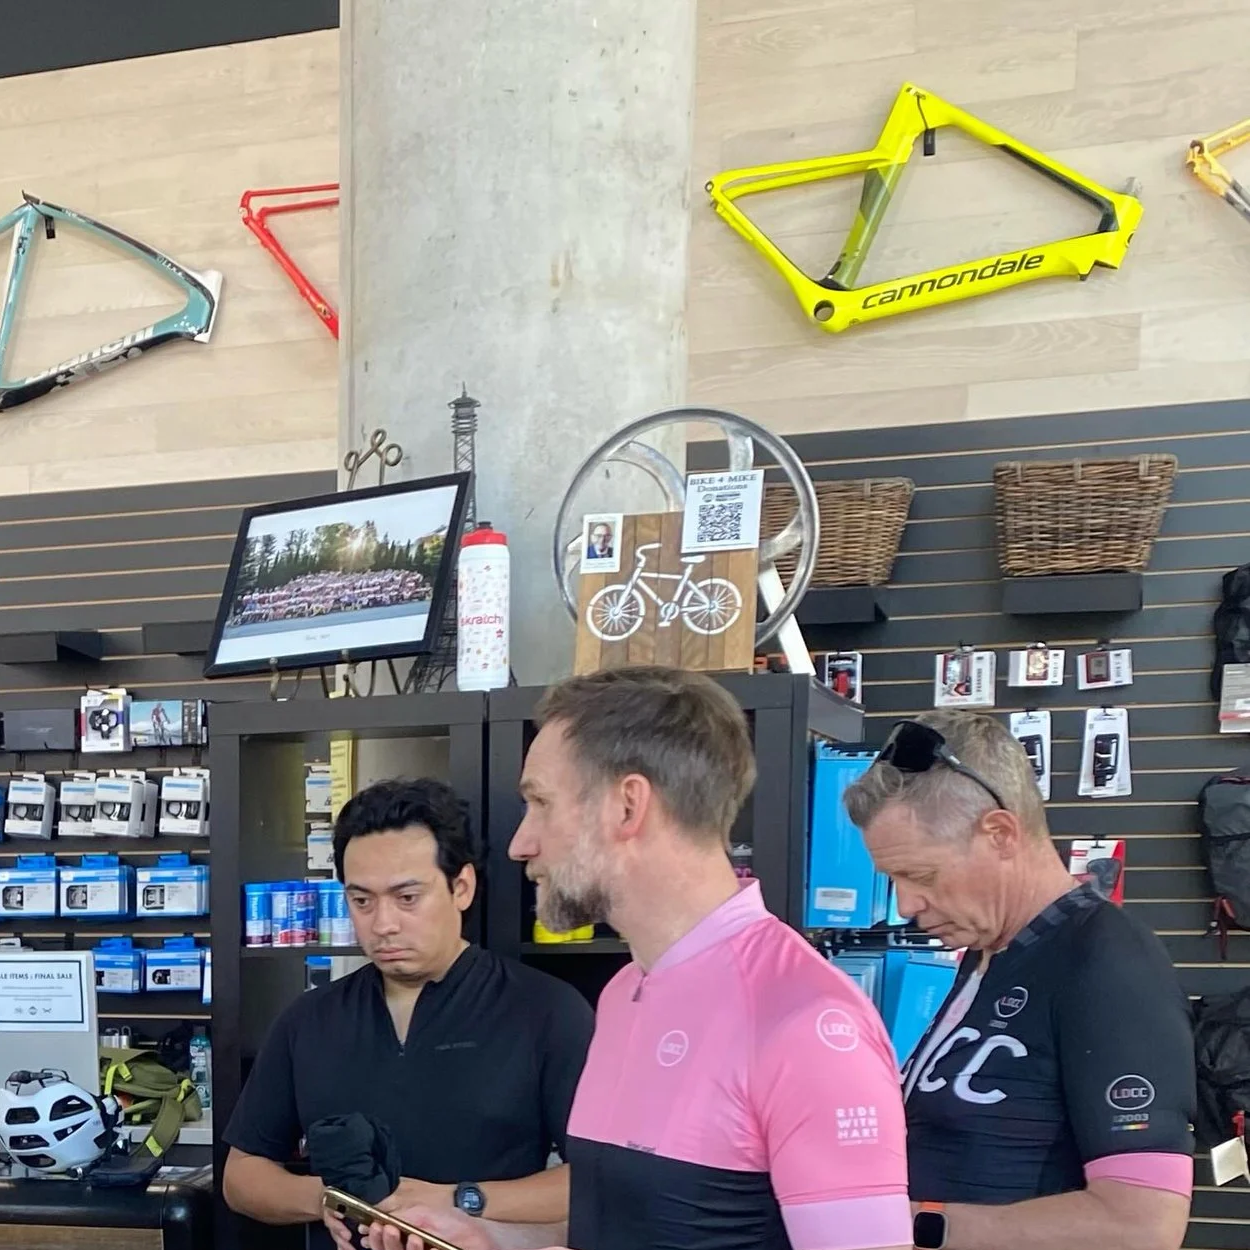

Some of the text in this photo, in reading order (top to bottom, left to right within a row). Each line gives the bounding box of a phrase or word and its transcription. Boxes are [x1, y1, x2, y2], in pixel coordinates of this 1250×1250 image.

[861, 253, 1045, 311] cannondale
[690, 477, 715, 486] BIKE
[728, 474, 758, 483] MIKE
[697, 483, 749, 493] Donations
[1111, 1086, 1149, 1100] LDCC
[835, 1106, 877, 1118] RIDE
[837, 1117, 879, 1129] WITH
[837, 1128, 879, 1140] HART
